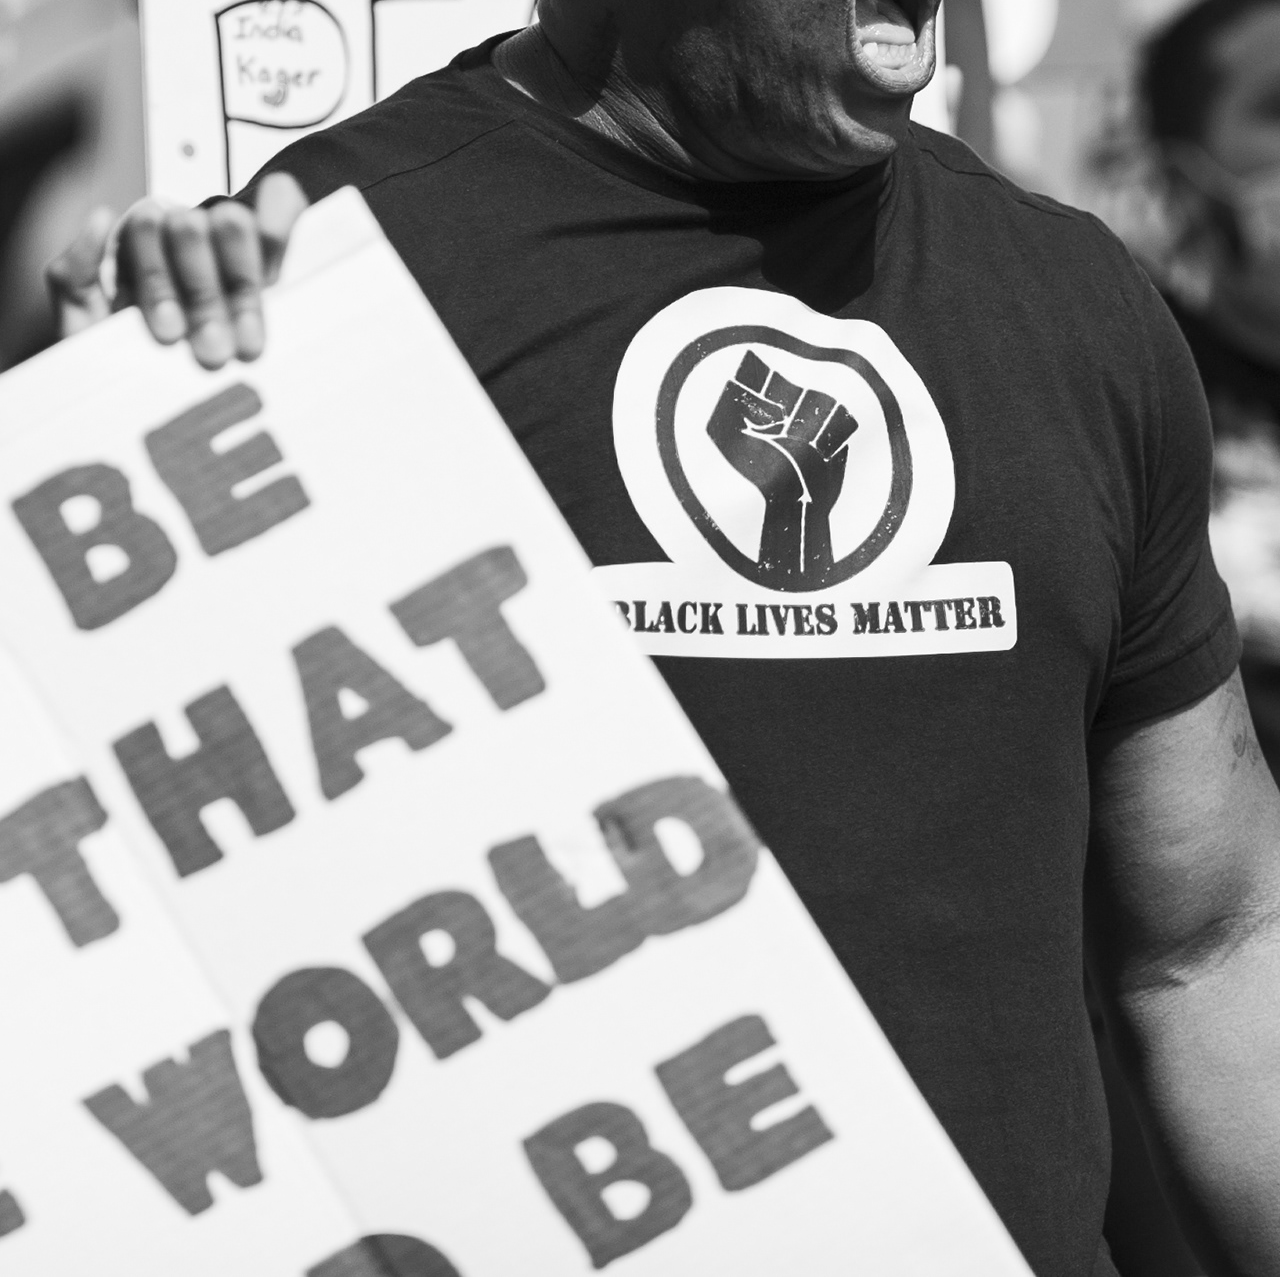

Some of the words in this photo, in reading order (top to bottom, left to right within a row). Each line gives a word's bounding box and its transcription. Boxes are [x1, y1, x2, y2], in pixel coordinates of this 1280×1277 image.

[9, 380, 312, 632] BE
[735, 602, 840, 636] LIVES
[849, 595, 1007, 635] MATTER
[81, 772, 764, 1218] WORLD
[521, 1013, 837, 1270] BE
